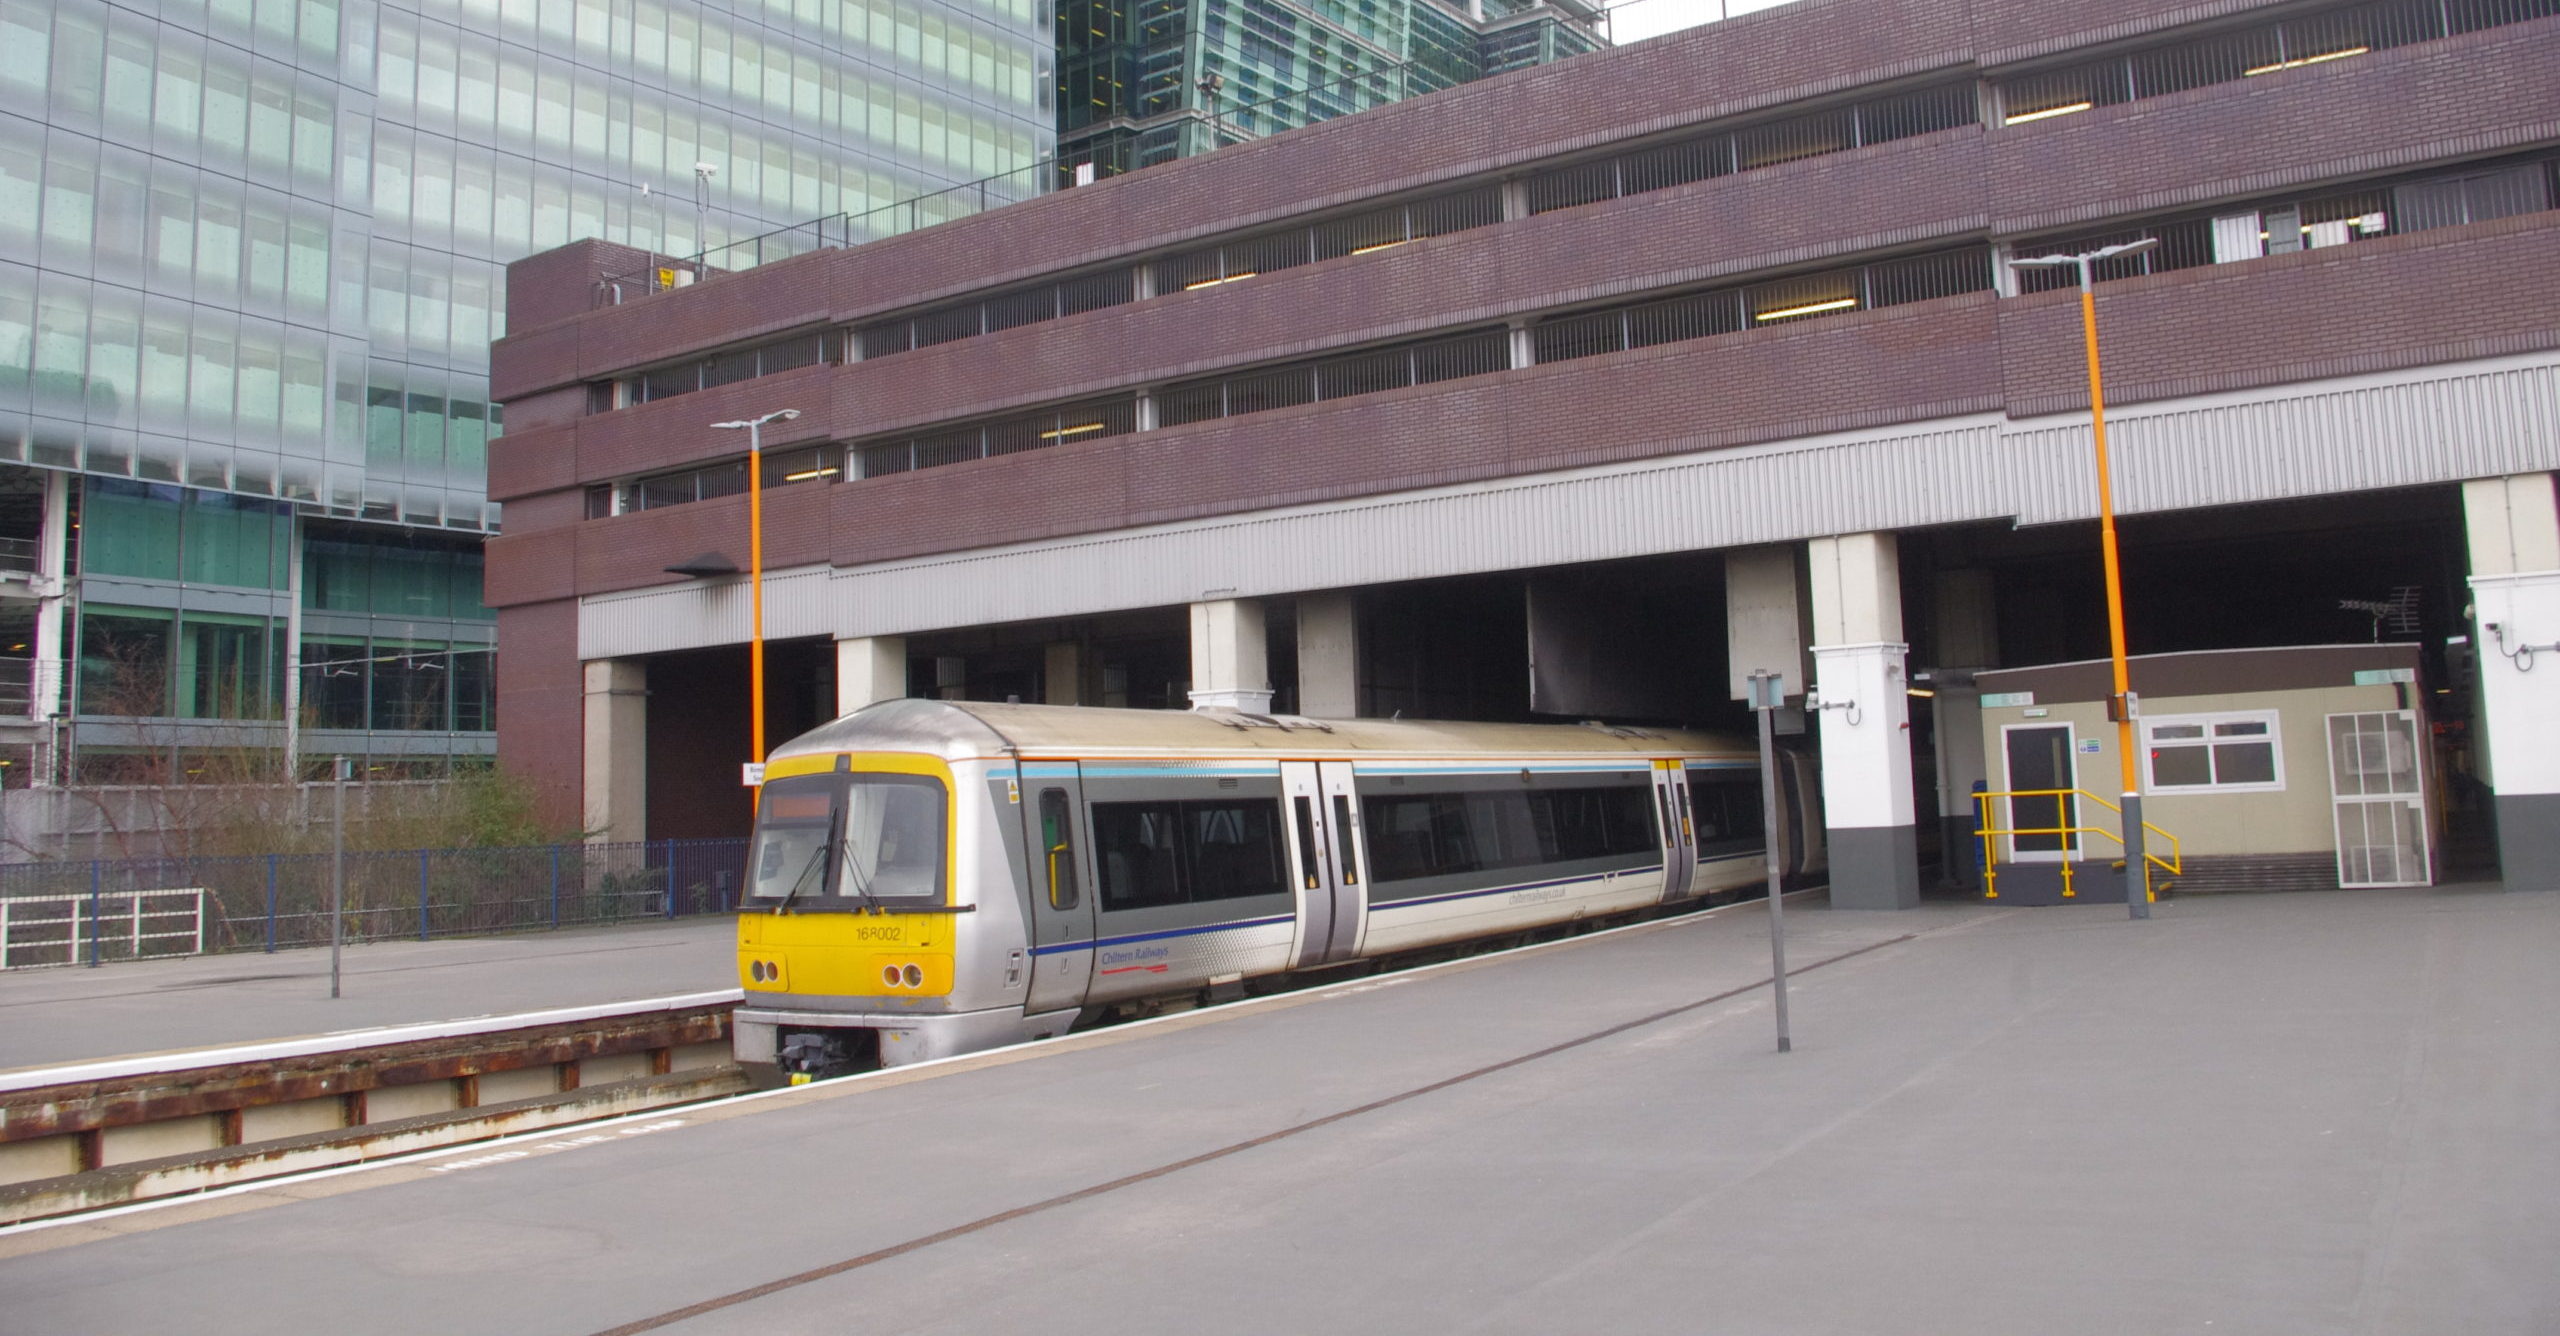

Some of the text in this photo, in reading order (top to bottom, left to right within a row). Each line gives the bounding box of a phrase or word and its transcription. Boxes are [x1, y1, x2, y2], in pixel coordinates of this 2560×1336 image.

[856, 926, 901, 941] 168002
[1102, 947, 1168, 964] Chiltern Railways
[426, 1119, 687, 1172] MIND THE GAP
